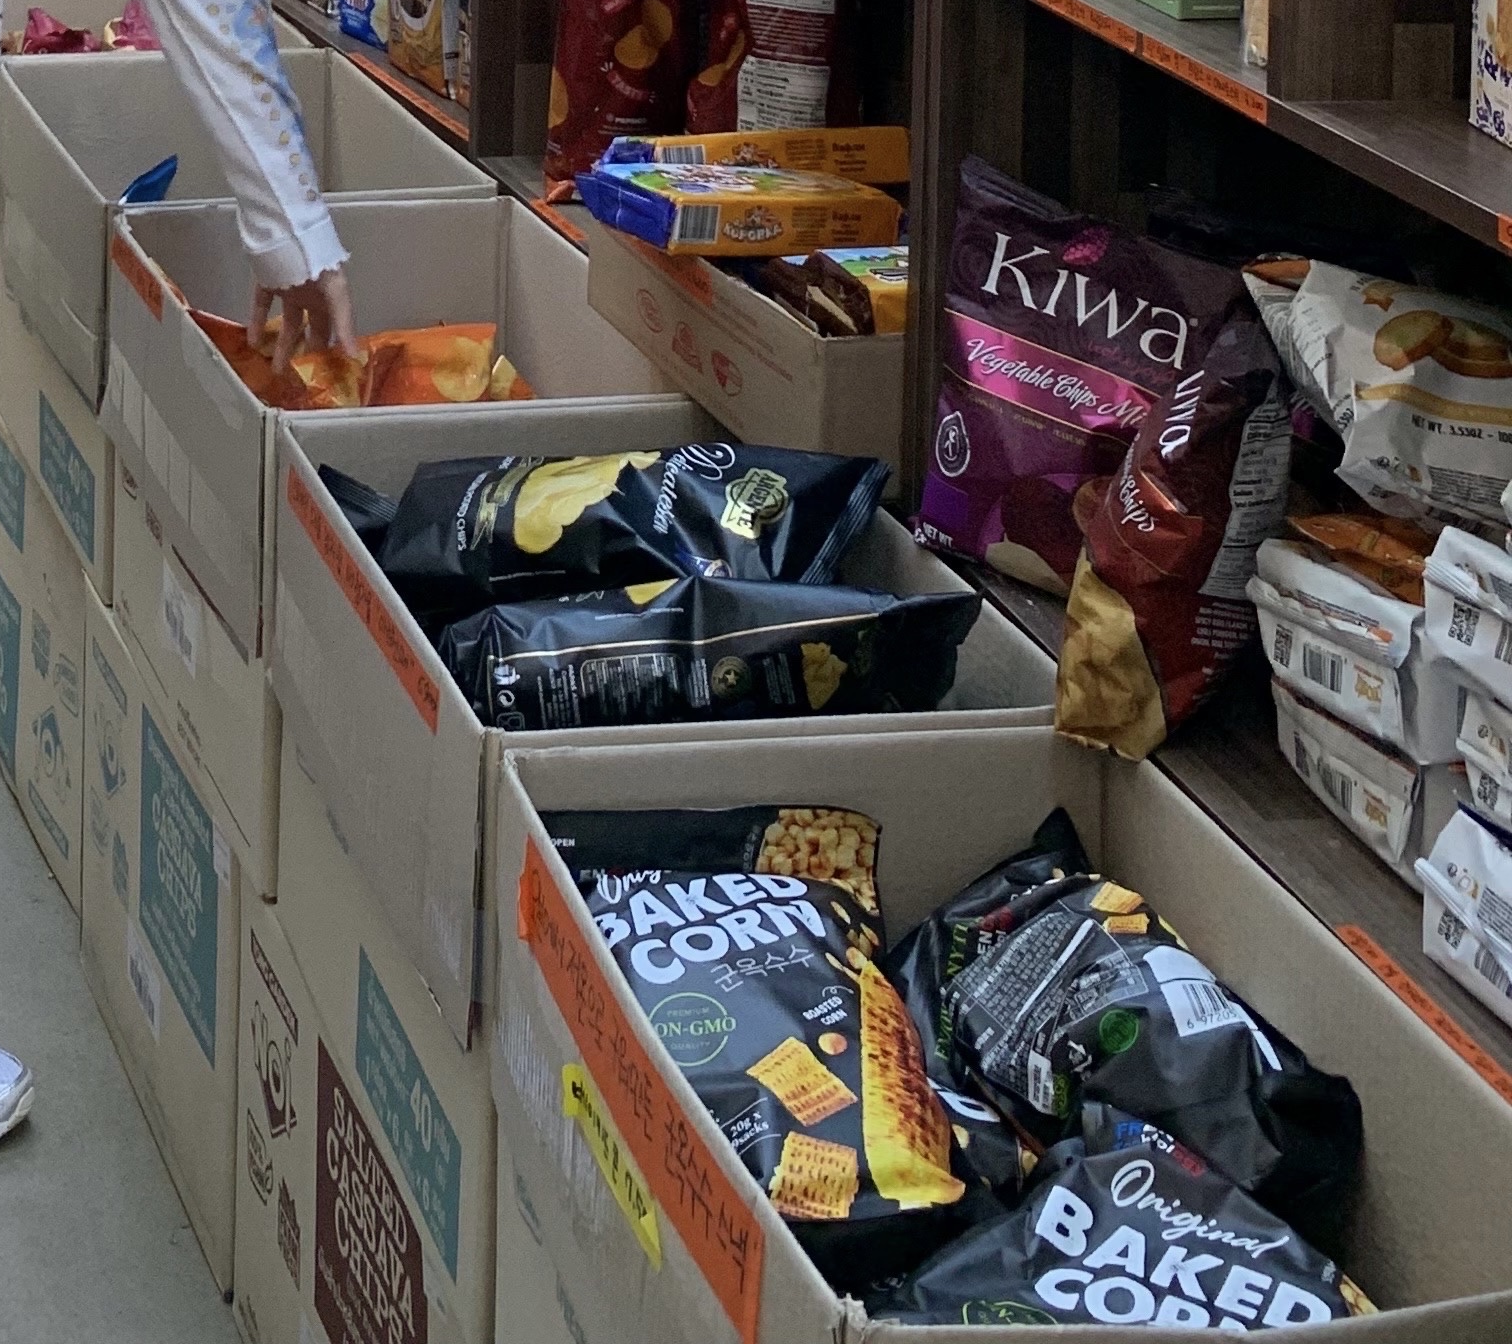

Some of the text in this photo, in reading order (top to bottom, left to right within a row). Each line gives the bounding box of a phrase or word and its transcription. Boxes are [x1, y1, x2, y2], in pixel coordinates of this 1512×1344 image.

[981, 232, 1191, 371] Kiwa
[967, 338, 1148, 430] Vegetable Chips Mi
[1412, 414, 1426, 432] NET
[550, 837, 575, 848] OPEN
[592, 873, 809, 951] BAKED
[630, 899, 827, 986] CORN
[710, 944, 816, 993] 군옥수수
[655, 1015, 737, 1038] ON-GMO
[666, 1006, 710, 1017] PREMIUM
[670, 1040, 711, 1051] QUALITY
[802, 995, 844, 1021] ROASTED
[820, 1010, 848, 1026] CORN
[410, 1076, 433, 1154] 40
[566, 939, 606, 1052] 저온으로
[664, 1101, 714, 1241] 군옥수수
[715, 1200, 750, 1295] 스낵
[333, 1086, 407, 1254] SALTED
[1110, 1158, 1290, 1260] Original
[326, 1127, 416, 1338] CASSAVA
[1035, 1184, 1333, 1330] BAKED
